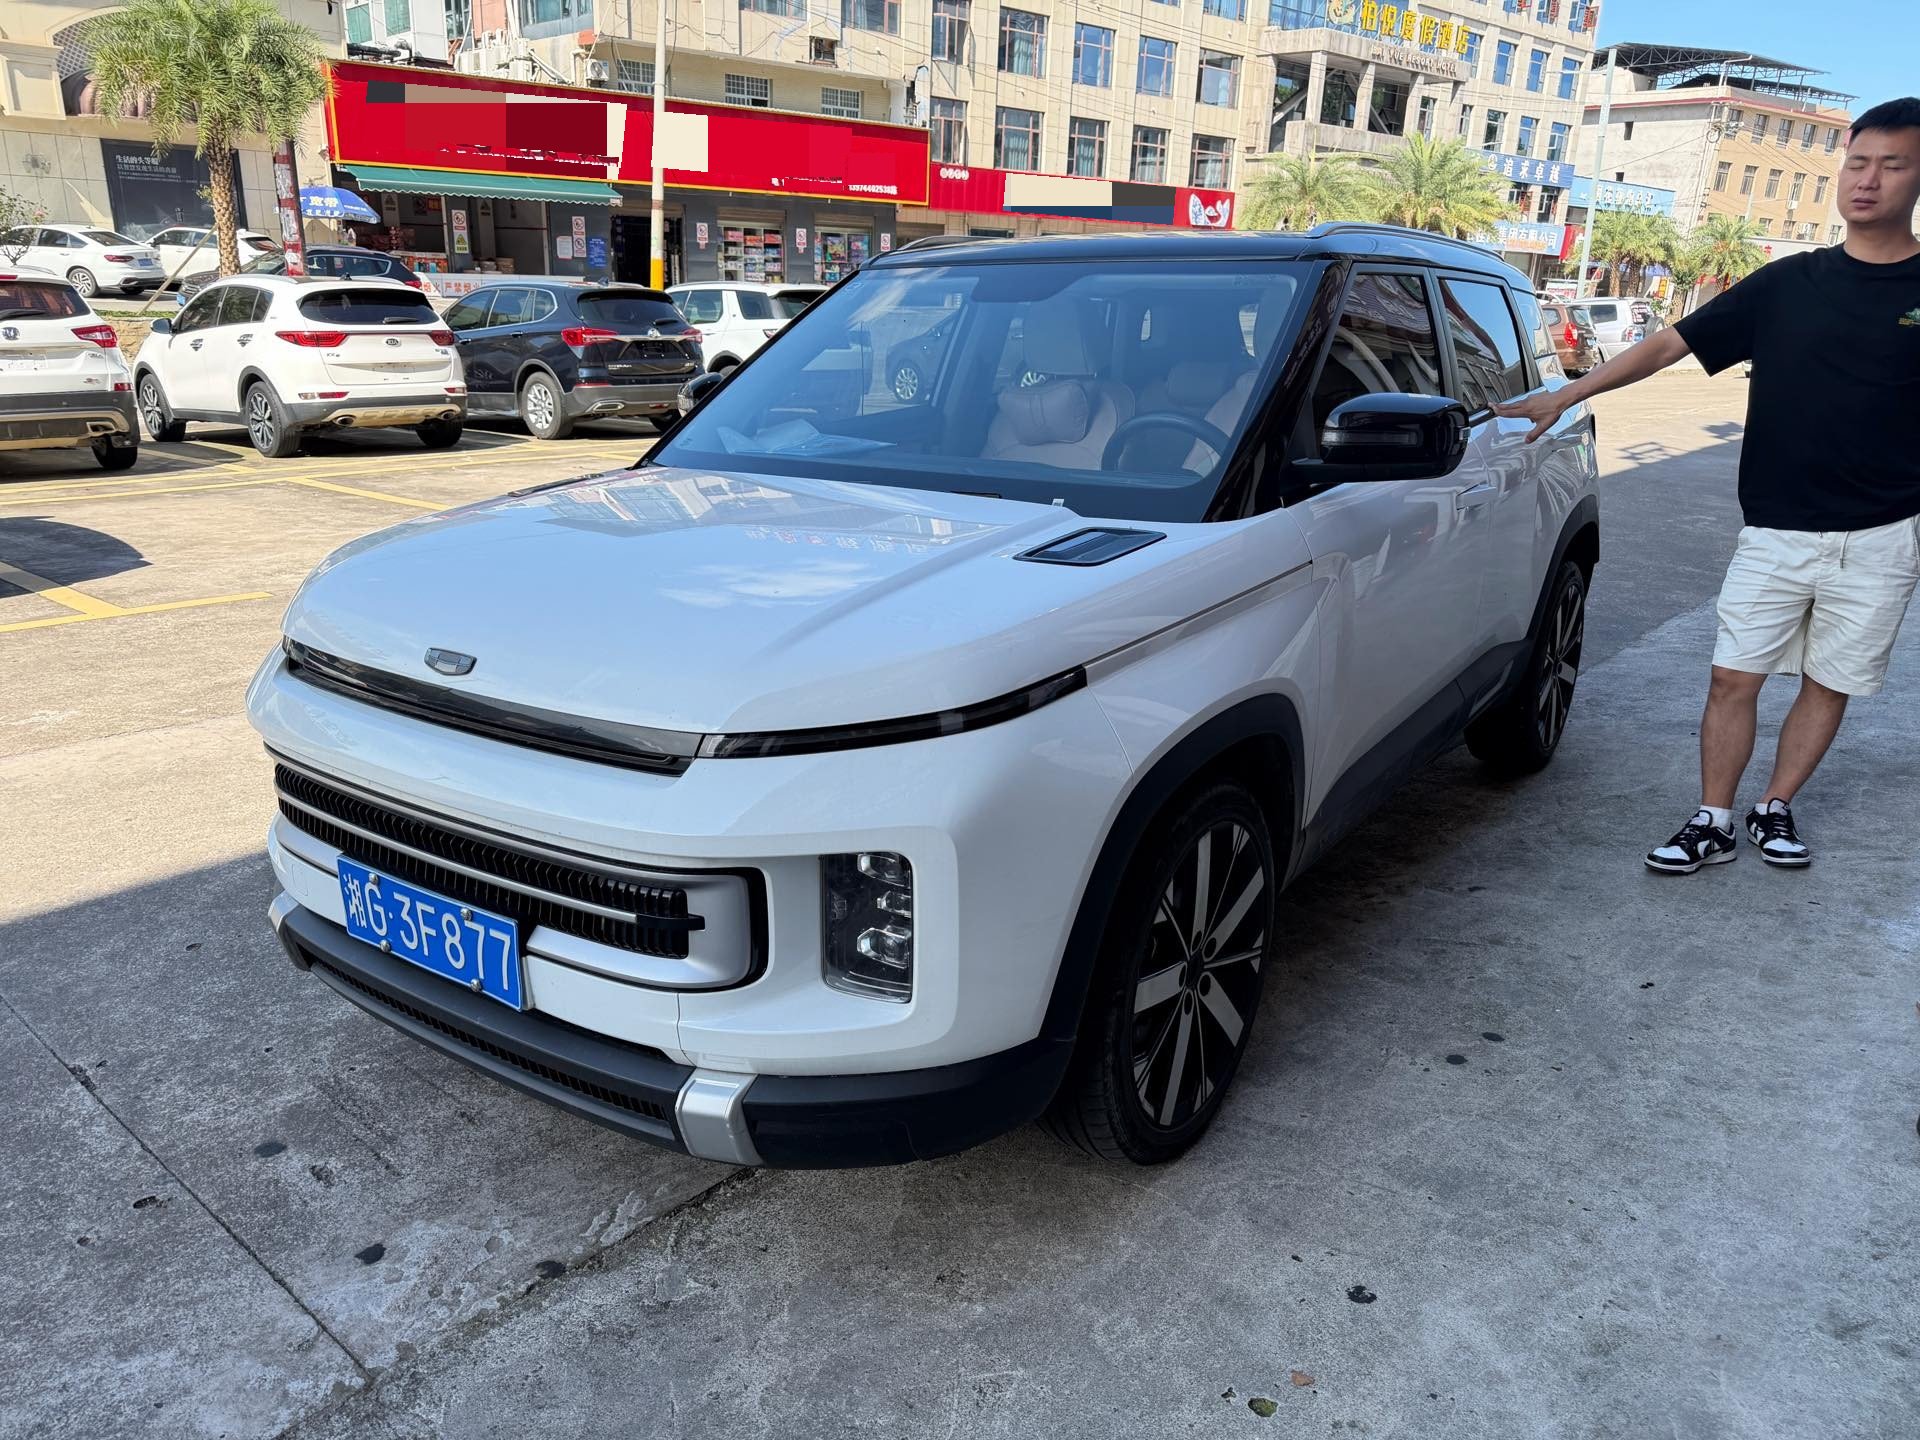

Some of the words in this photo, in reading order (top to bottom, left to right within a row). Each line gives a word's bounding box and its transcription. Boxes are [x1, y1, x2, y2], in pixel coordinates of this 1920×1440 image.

[1407, 54, 1434, 68] RESORT
[1437, 58, 1458, 73] HOTEL
[1503, 157, 1560, 184] 追求卓越
[300, 196, 339, 208] 宽带
